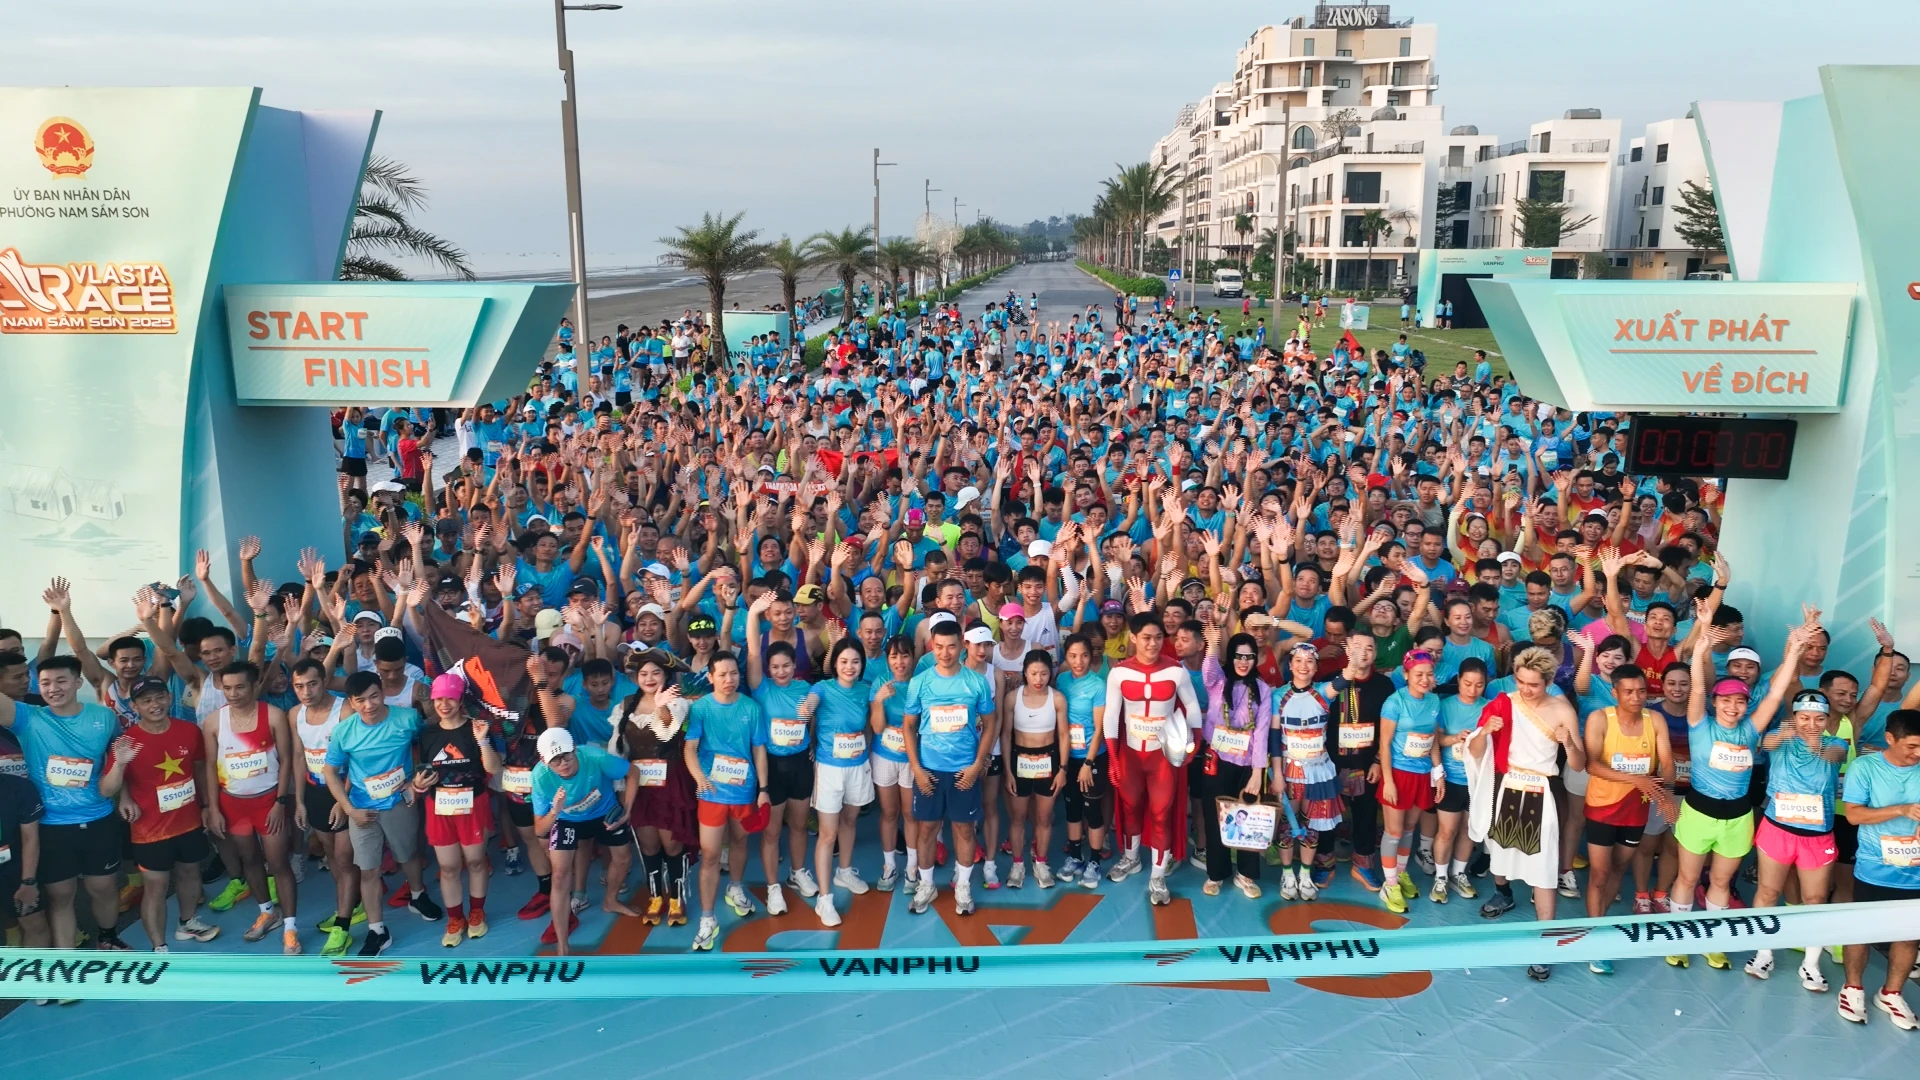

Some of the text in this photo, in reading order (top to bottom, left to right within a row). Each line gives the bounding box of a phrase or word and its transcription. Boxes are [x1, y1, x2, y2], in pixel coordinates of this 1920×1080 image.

[34, 190, 60, 201] BAN
[64, 187, 99, 201] NHÂN
[104, 187, 130, 201] DÂN
[59, 207, 88, 218] NAM
[122, 206, 150, 218] SƠN
[69, 264, 167, 284] VLASTA
[3, 317, 42, 327] NAM
[90, 315, 126, 327] SƠN
[130, 317, 172, 327] 2025
[247, 310, 369, 341] START
[1613, 309, 1790, 342] XUẤT PHÁT
[303, 358, 431, 388] FINISH
[1681, 362, 1809, 394] VỀ ĐÍCH
[774, 729, 802, 737] SS10607
[1133, 723, 1162, 732] SS10252
[887, 734, 904, 743] SS10
[1216, 735, 1245, 746] SS10311
[0, 763, 28, 773] SS100
[230, 758, 263, 770] SS10797
[716, 765, 745, 775] SS10401
[1019, 762, 1049, 770] SS10900
[1616, 763, 1646, 771] SS11120
[50, 766, 88, 777] SS10622
[1508, 771, 1541, 783] SS10289
[371, 775, 401, 792] SS10217
[163, 786, 193, 802] SS10142
[438, 797, 469, 805] SS10919
[1612, 914, 1782, 943] VANPHU
[1217, 937, 1380, 964] VANPHU
[0, 958, 170, 985] VANPHU
[819, 955, 980, 977] VANPHU
[420, 961, 586, 985] VANPHU
